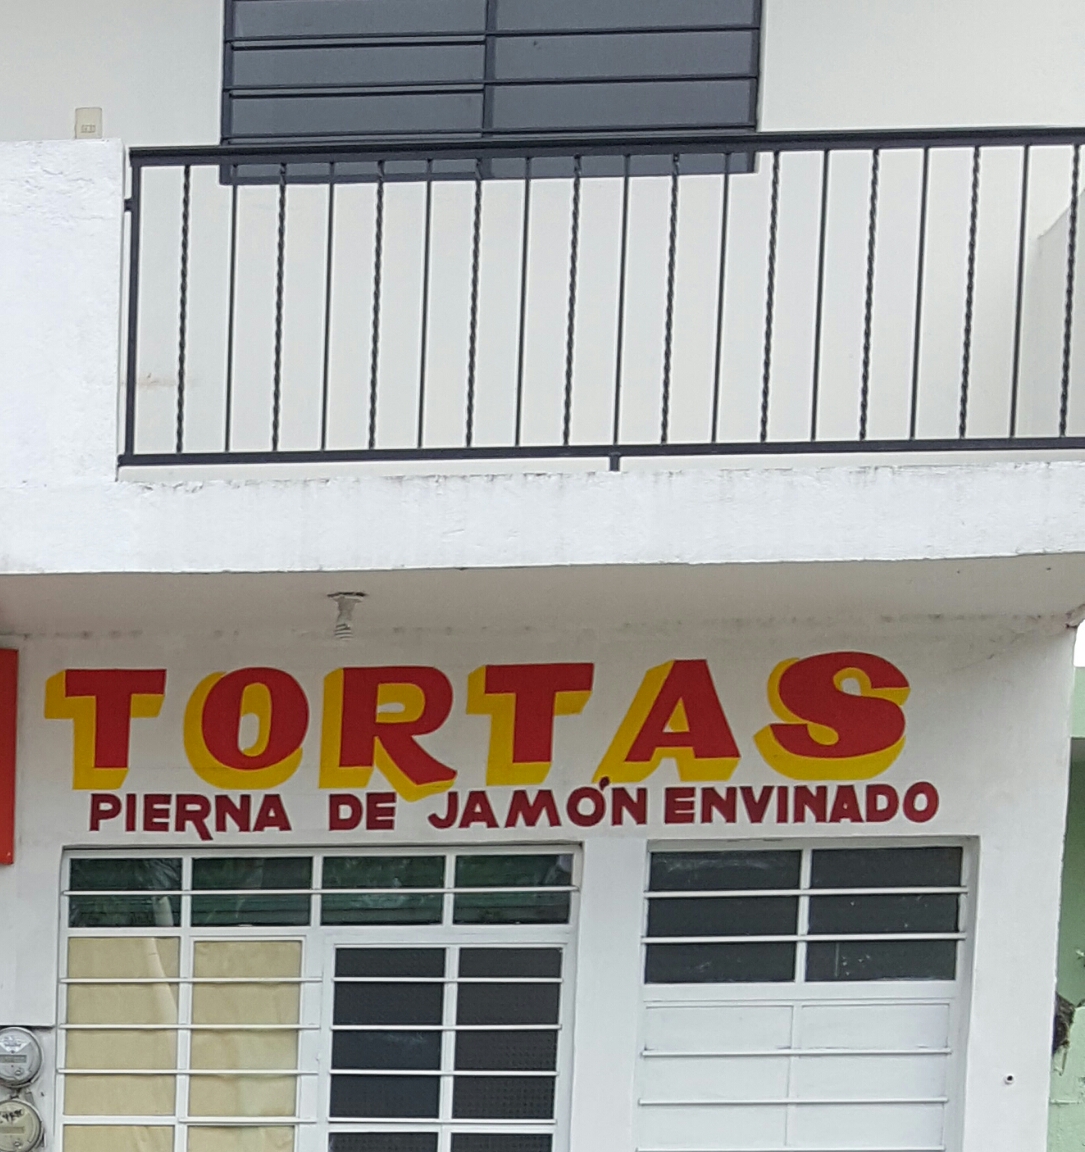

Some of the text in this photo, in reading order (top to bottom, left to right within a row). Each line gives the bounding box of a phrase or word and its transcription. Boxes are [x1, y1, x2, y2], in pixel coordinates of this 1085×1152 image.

[44, 651, 911, 801] TORTAS
[88, 777, 941, 841] PIERNA DE JAMÓN ENVINADO
